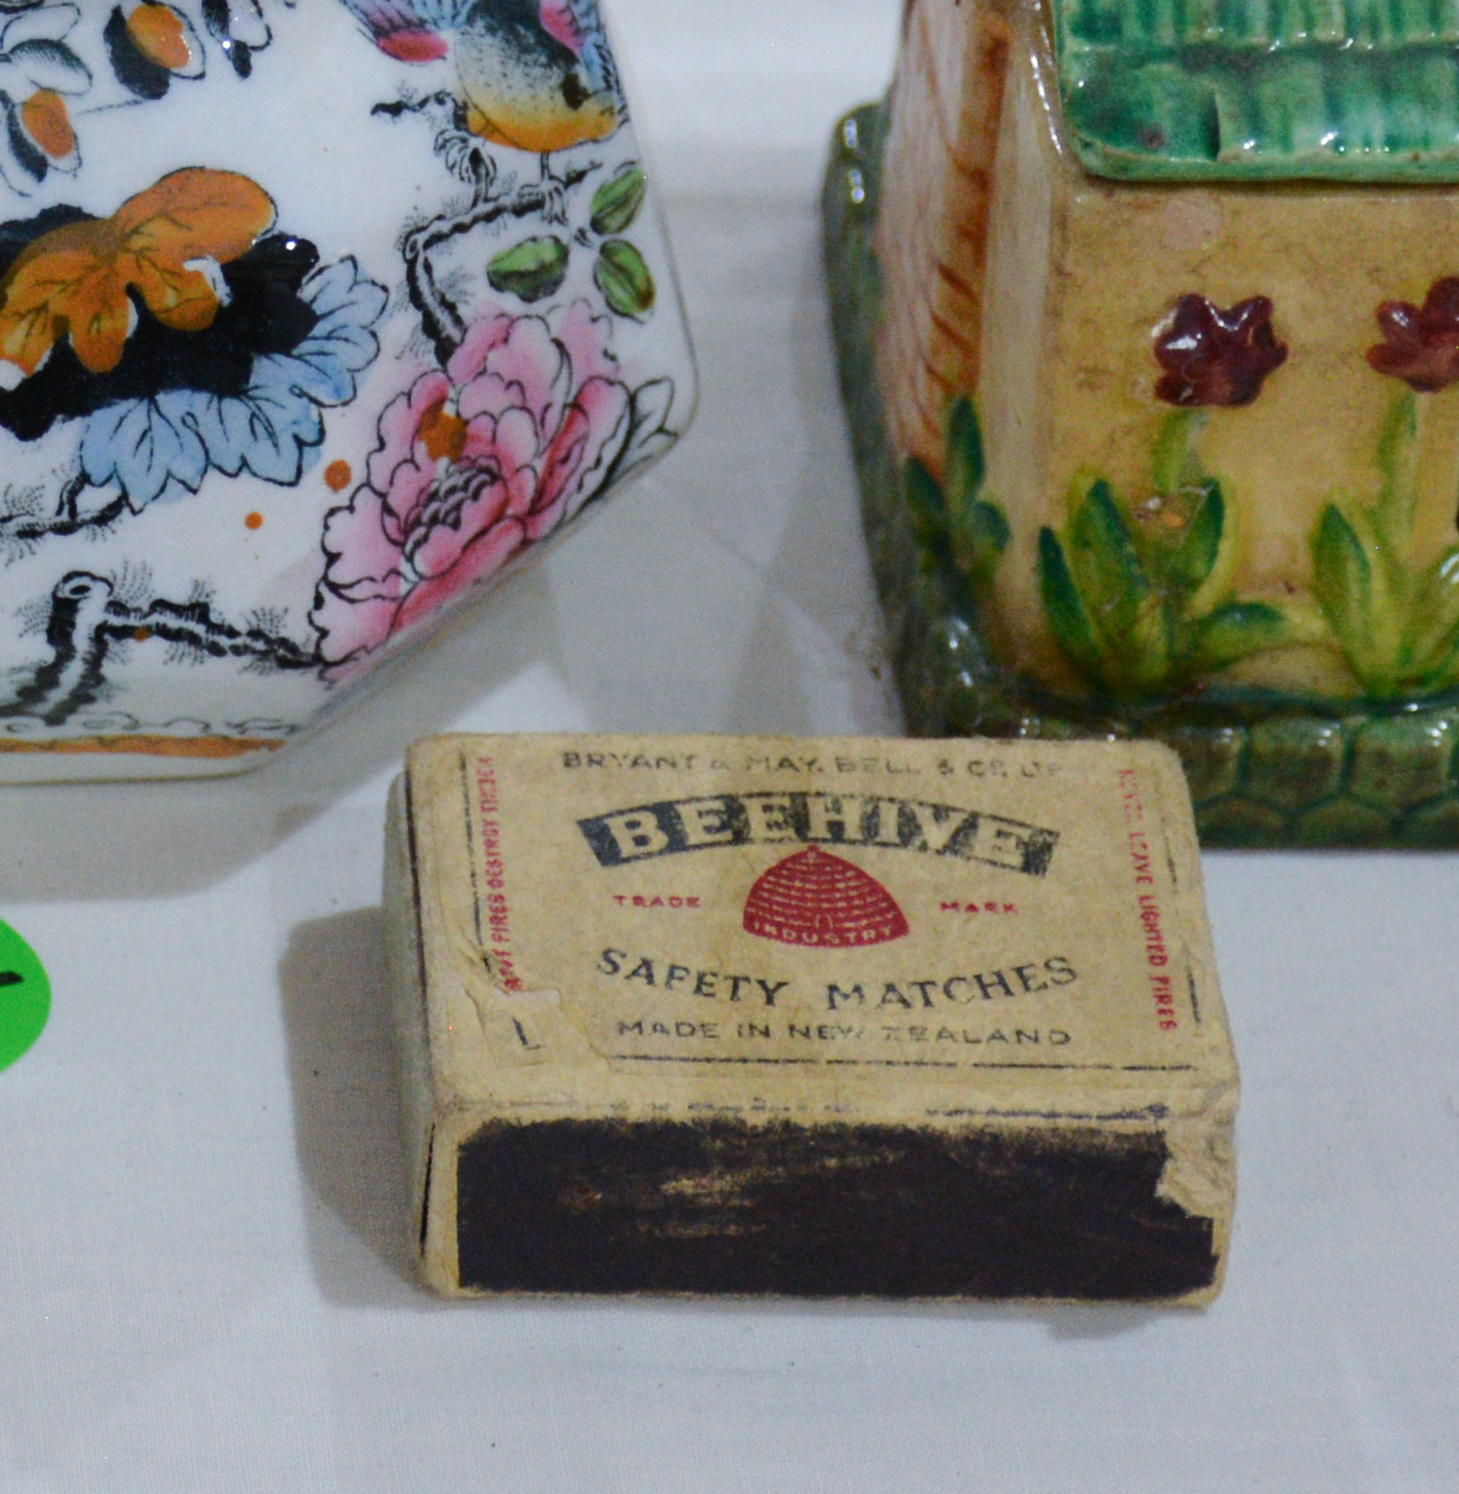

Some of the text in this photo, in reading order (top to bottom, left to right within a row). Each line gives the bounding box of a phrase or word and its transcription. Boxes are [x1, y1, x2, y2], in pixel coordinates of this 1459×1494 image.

[563, 751, 699, 770] BRYANT
[600, 792, 1026, 869] BEEHIVE
[613, 894, 701, 908] TRADE
[940, 900, 1019, 914] MARK
[753, 920, 894, 944] INDUSTRY
[596, 948, 1078, 1010] SAFETY MATCHES
[617, 1020, 721, 1039] MADE
[736, 1022, 772, 1039] IN
[881, 1025, 1072, 1046] ZEALAND
